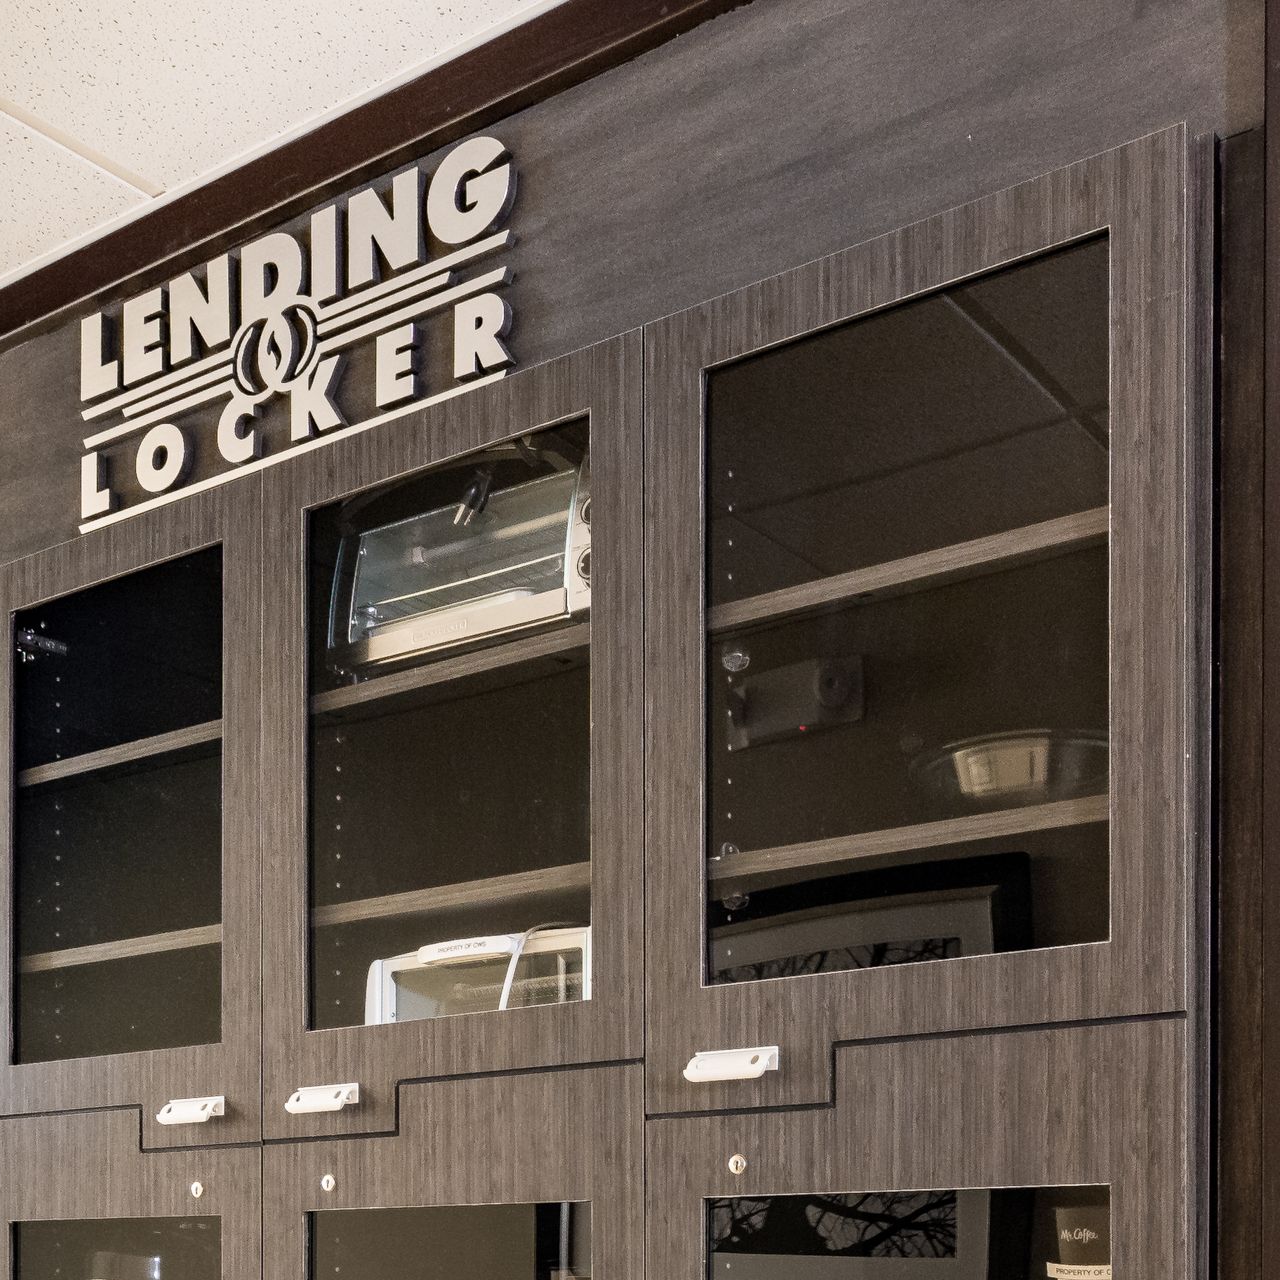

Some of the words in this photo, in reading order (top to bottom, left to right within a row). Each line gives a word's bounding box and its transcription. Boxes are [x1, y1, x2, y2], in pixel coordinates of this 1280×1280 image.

[81, 136, 516, 401] LENDING
[81, 293, 513, 519] LOCKER
[1056, 1267, 1091, 1276] PROPERTY
[1094, 1268, 1104, 1276] OF
[1061, 1229, 1074, 1242] Mr.
[1074, 1228, 1097, 1243] Coffee
